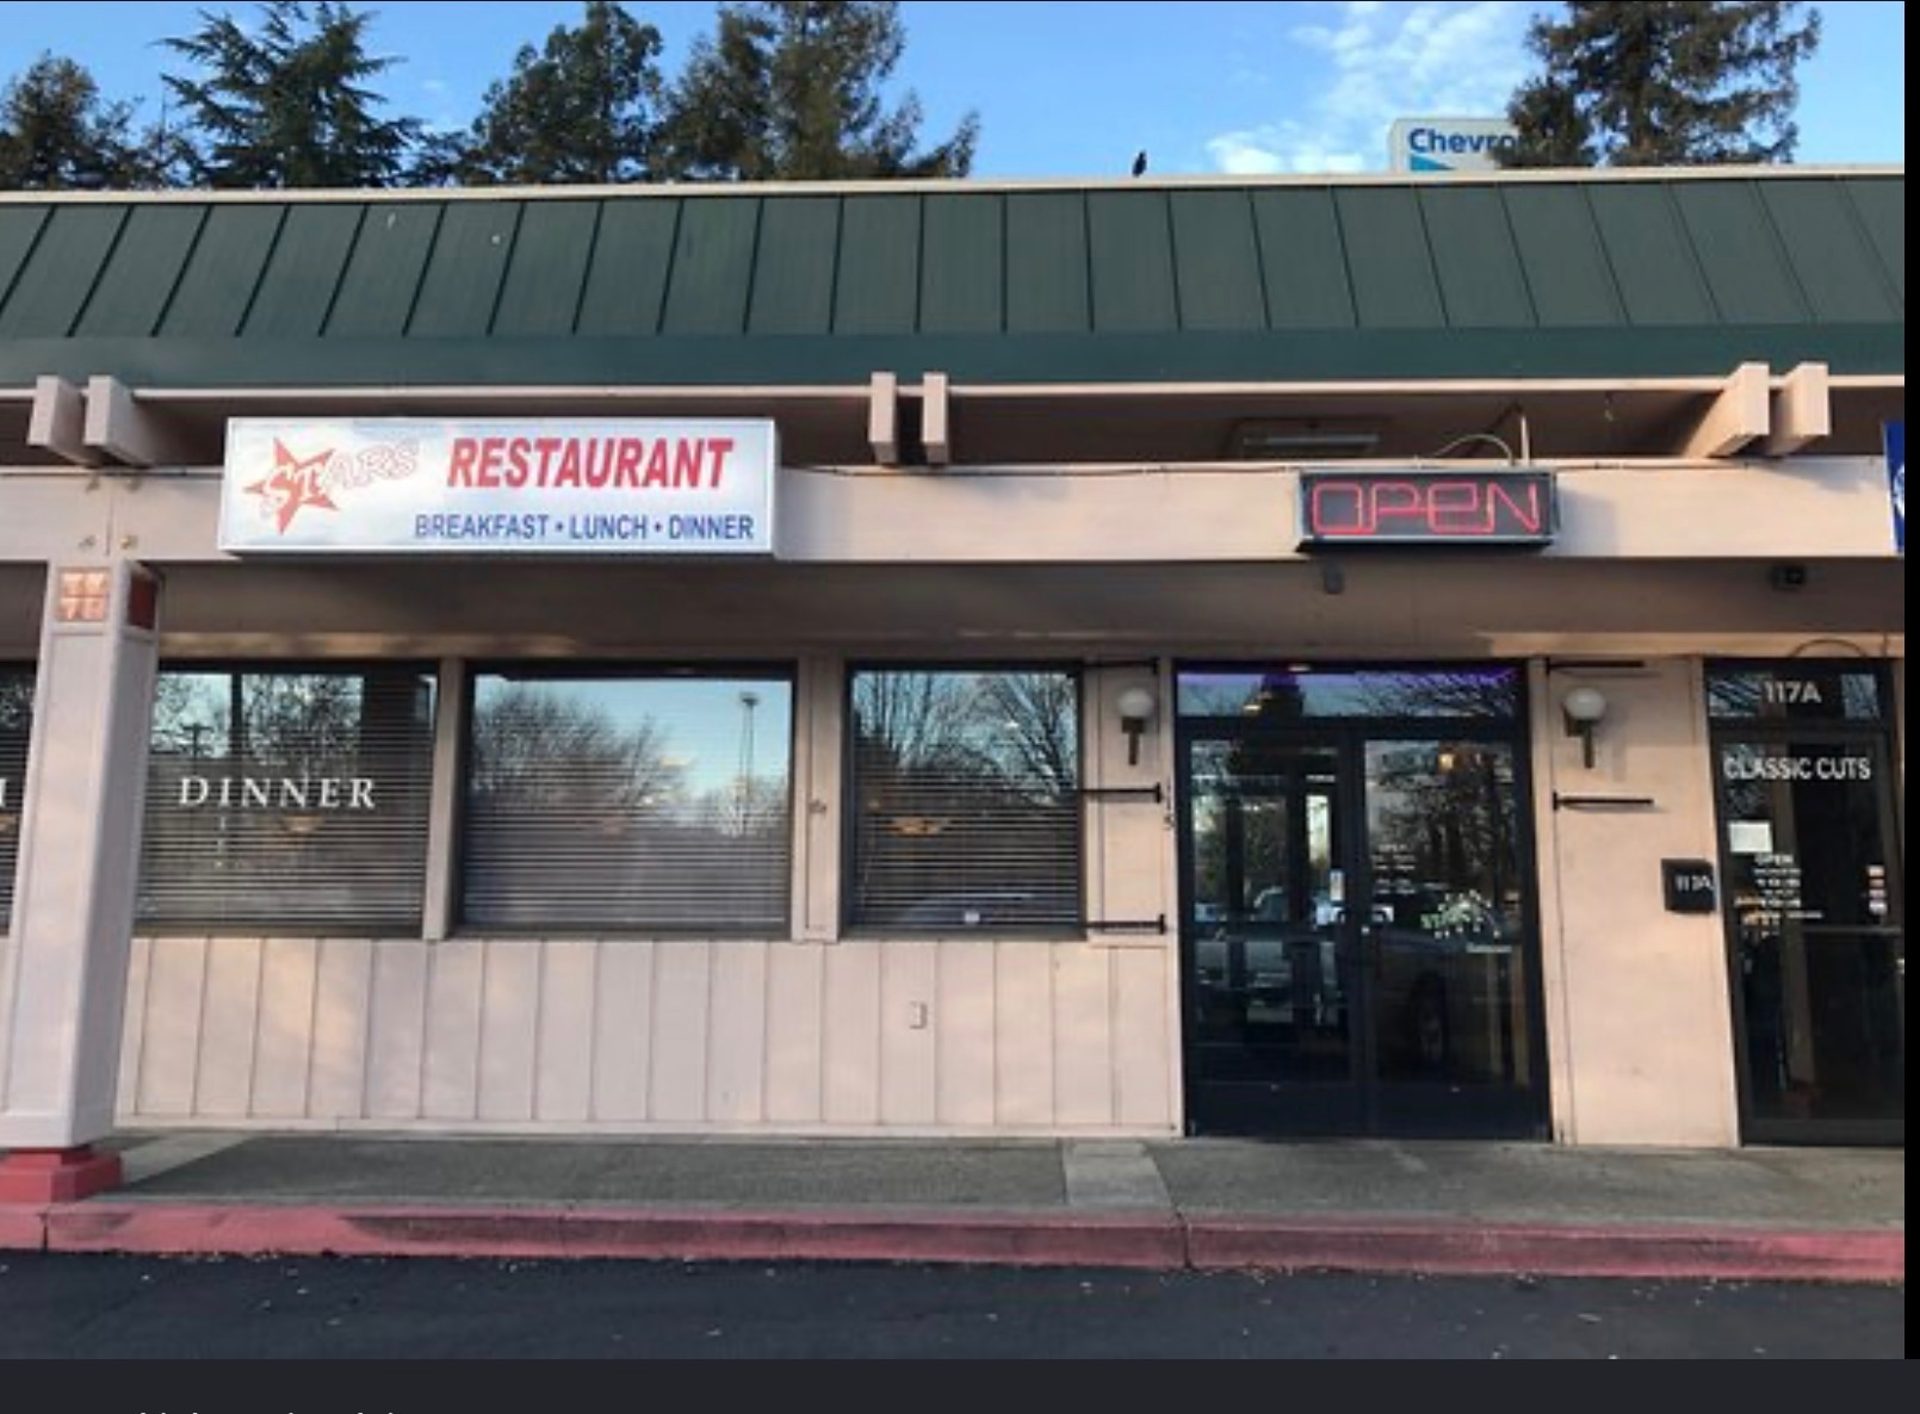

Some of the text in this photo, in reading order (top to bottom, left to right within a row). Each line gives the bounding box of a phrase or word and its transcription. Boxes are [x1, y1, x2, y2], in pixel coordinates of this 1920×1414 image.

[1408, 126, 1524, 153] Chevro
[447, 437, 735, 488] RESTAURANT
[414, 513, 754, 541] BREAKFAST LUNCH DINNER
[1764, 680, 1823, 703] 117A
[1723, 757, 1871, 780] CLASSIC CUTS
[178, 777, 376, 809] DINNER
